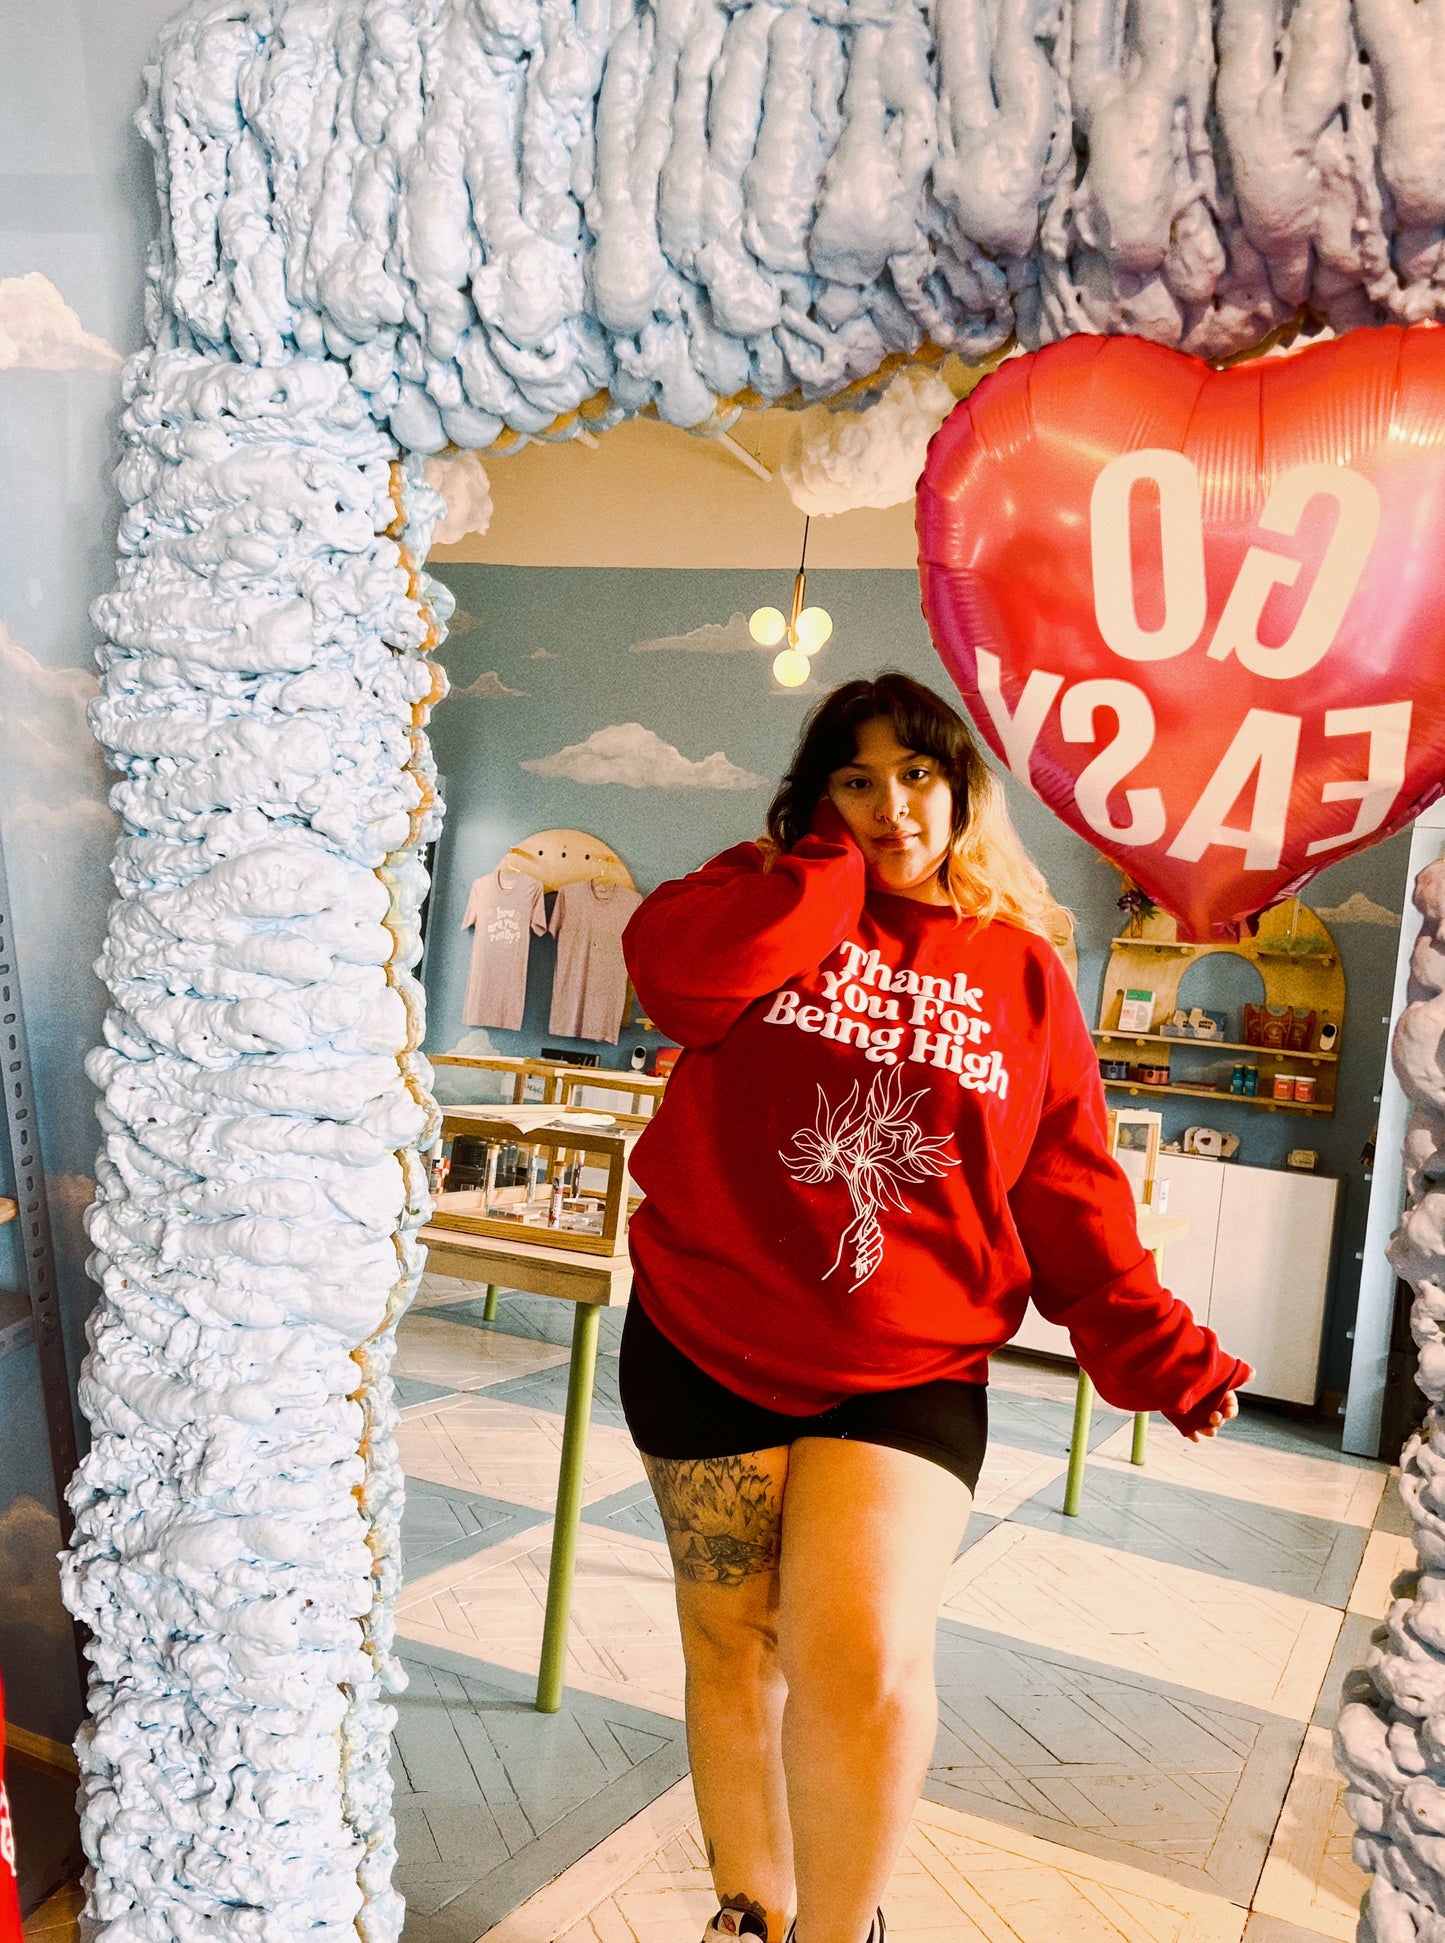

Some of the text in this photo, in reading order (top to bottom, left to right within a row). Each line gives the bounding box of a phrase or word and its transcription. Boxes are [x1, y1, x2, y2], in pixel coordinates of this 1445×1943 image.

[496, 906, 515, 920] how
[821, 970, 992, 1045] You For
[839, 940, 983, 1012] Thank
[763, 990, 1009, 1100] Being High
